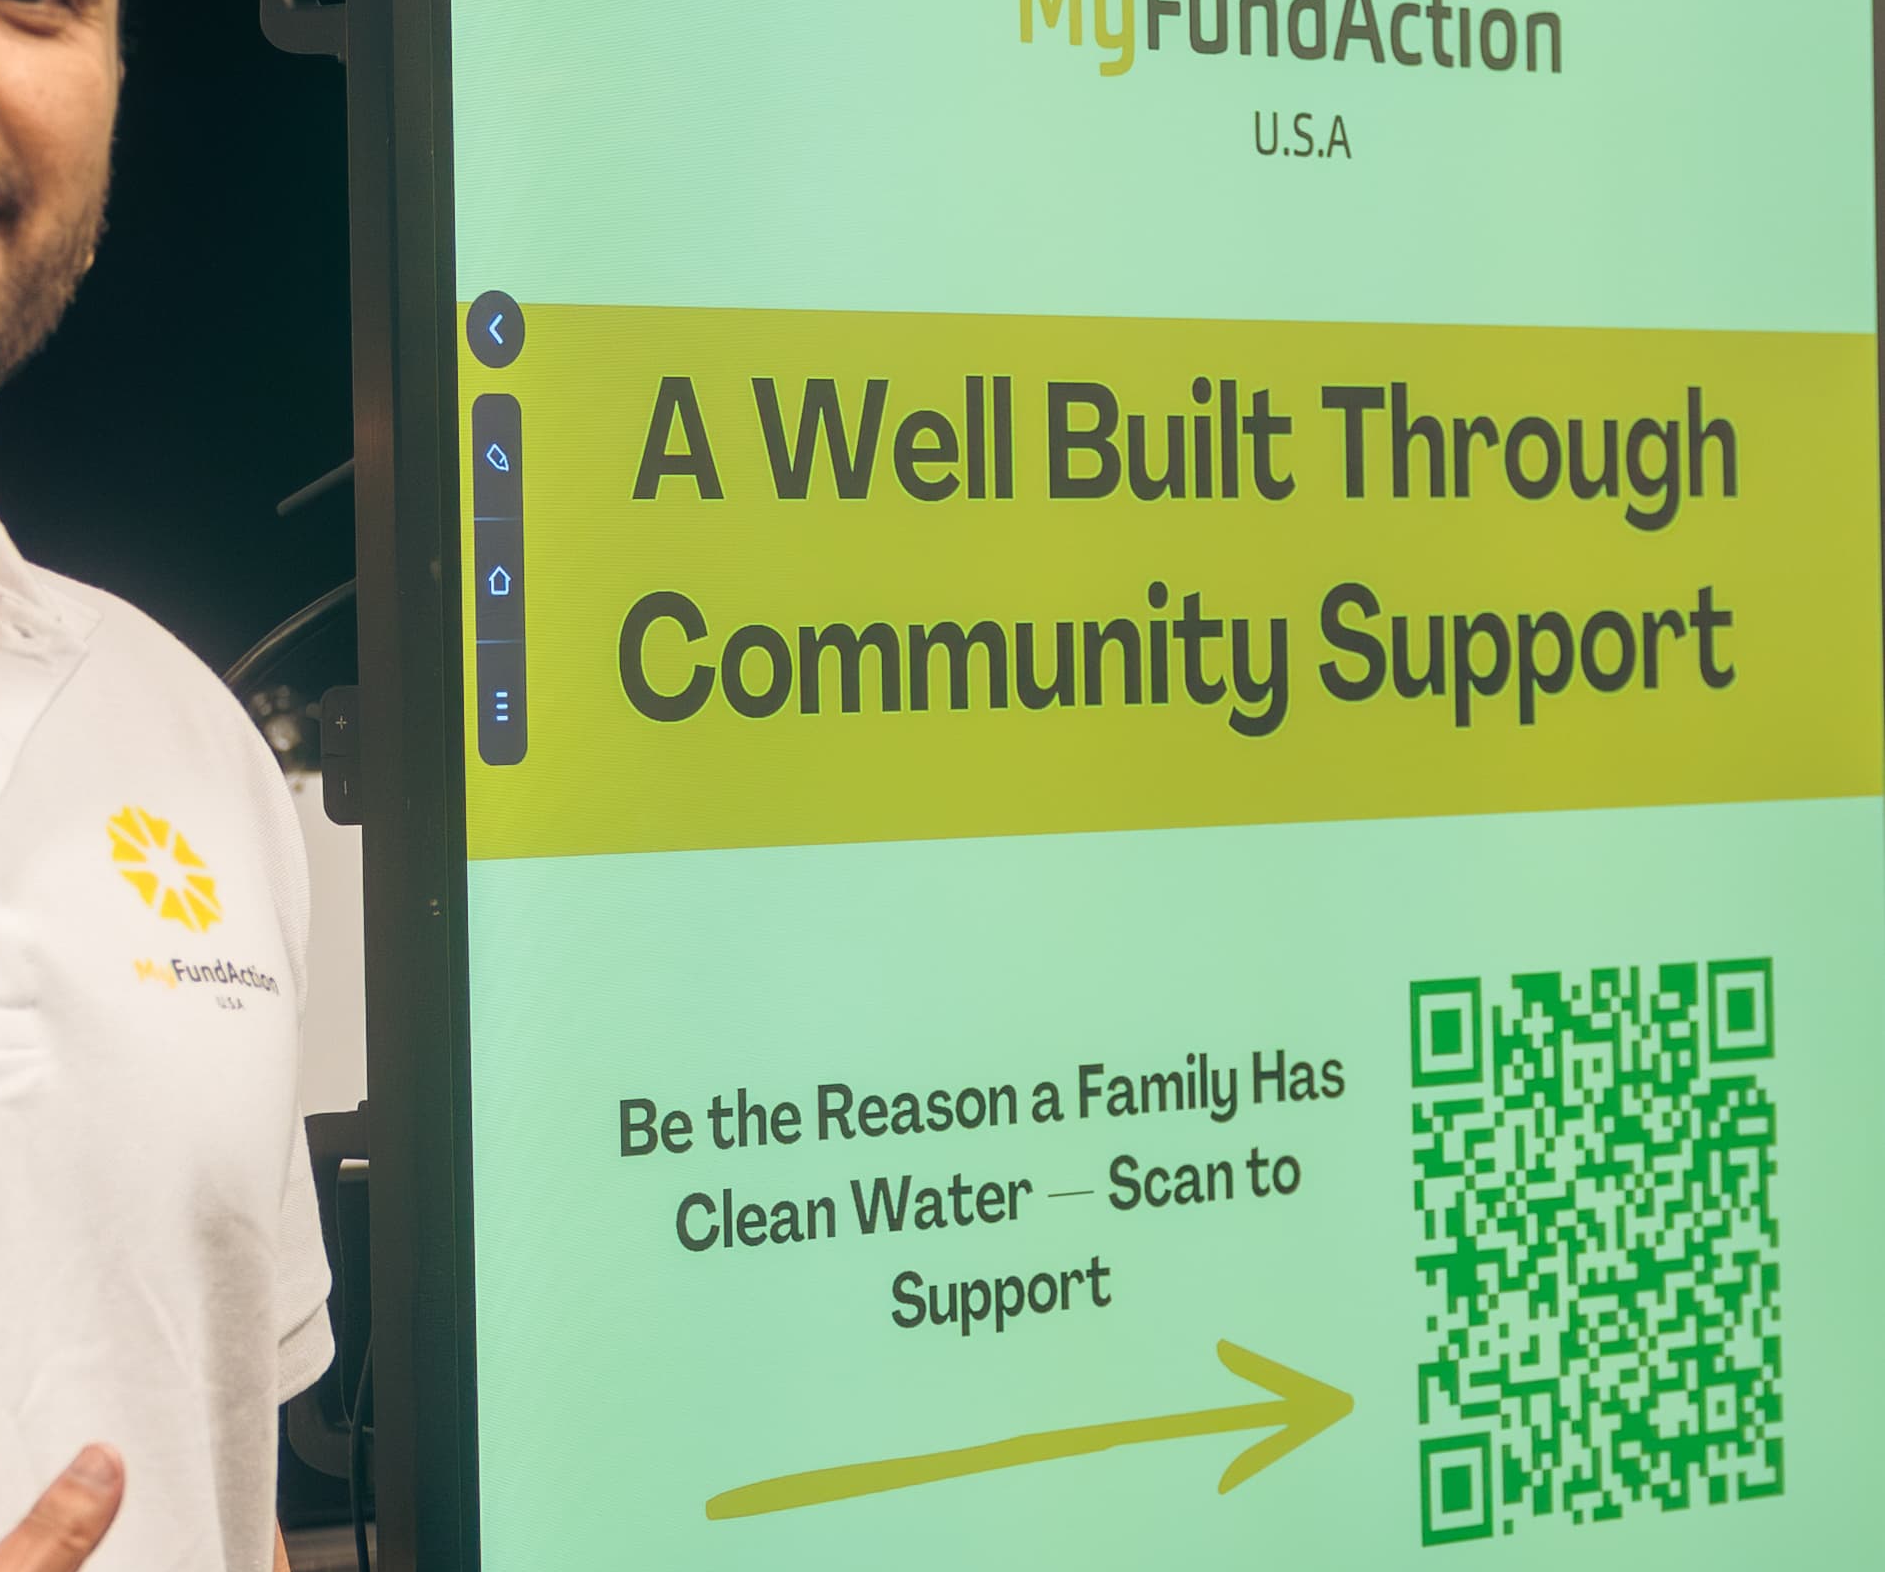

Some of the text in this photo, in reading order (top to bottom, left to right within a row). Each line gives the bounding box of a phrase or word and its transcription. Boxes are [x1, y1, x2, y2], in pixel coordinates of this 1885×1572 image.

[1254, 110, 1353, 160] U.S.A
[632, 375, 1738, 532] A Well Built Through
[618, 581, 1735, 737] Community Support
[133, 958, 280, 996] MyFundAction
[619, 1049, 1345, 1158] Be the Reason a Family Has
[675, 1188, 837, 1252] Clean
[849, 1173, 1034, 1235] Water
[1108, 1154, 1234, 1211] Scan
[1245, 1147, 1302, 1198] to
[891, 1255, 1113, 1337] Support
